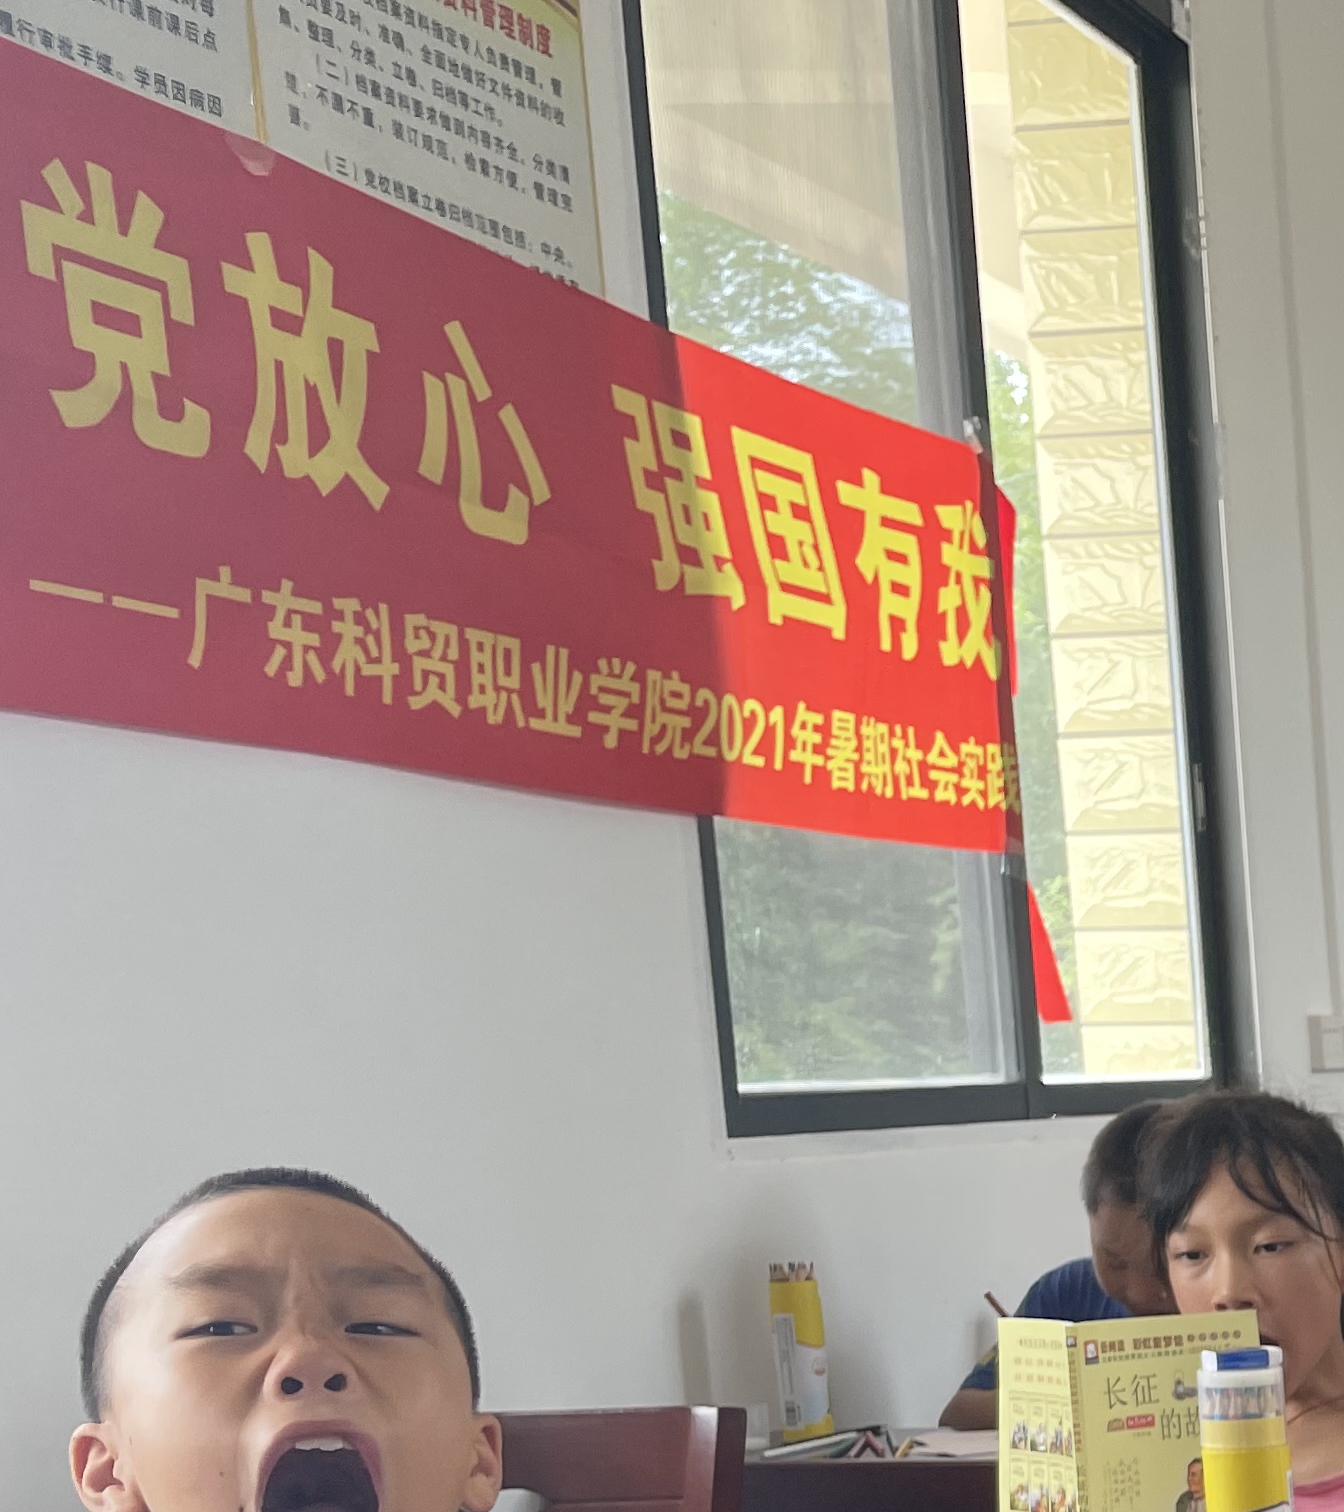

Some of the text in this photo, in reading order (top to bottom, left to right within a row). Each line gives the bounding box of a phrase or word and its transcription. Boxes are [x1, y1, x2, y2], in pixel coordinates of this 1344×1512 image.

[20, 157, 1001, 681] 党放心 强国有我
[1103, 1373, 1160, 1410] 长征
